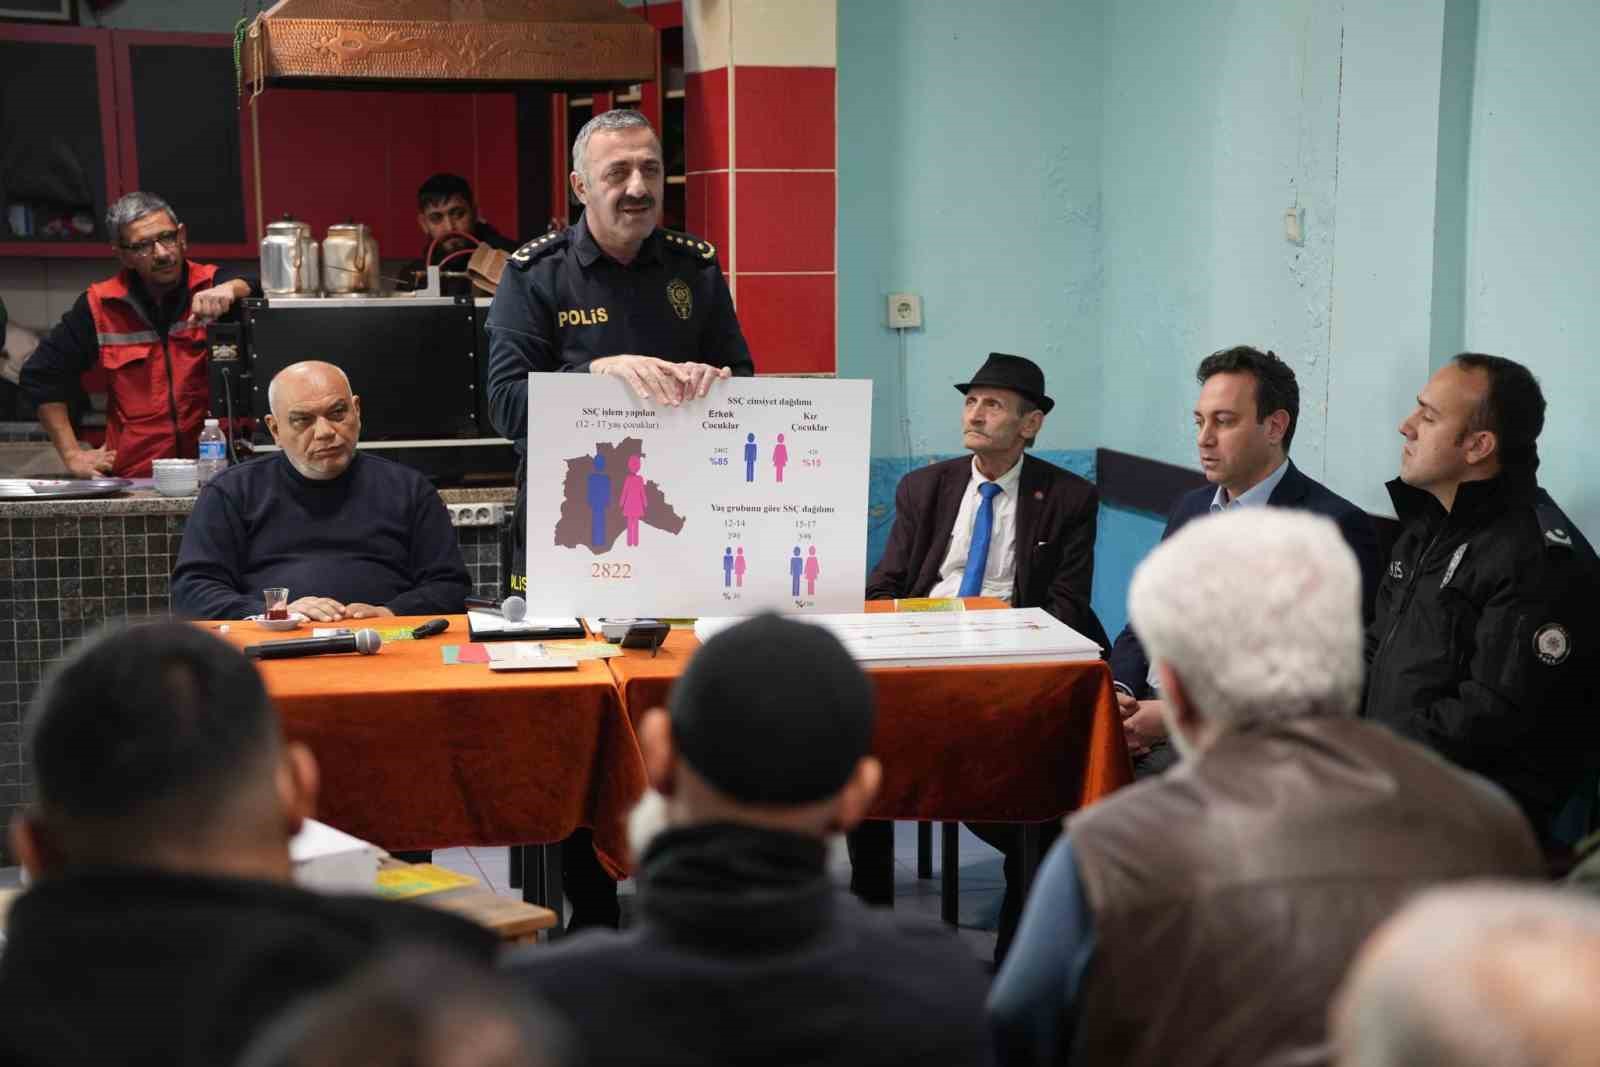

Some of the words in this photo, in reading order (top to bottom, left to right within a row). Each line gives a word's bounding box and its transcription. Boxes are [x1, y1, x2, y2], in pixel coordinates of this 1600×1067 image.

[747, 397, 777, 406] cinsiyet
[625, 408, 656, 419] yapılan
[708, 409, 735, 418] Erkek
[702, 420, 740, 431] Çocuklar
[791, 422, 830, 432] Çocuklar
[724, 519, 746, 528] 12-14
[591, 562, 632, 579] 2822
